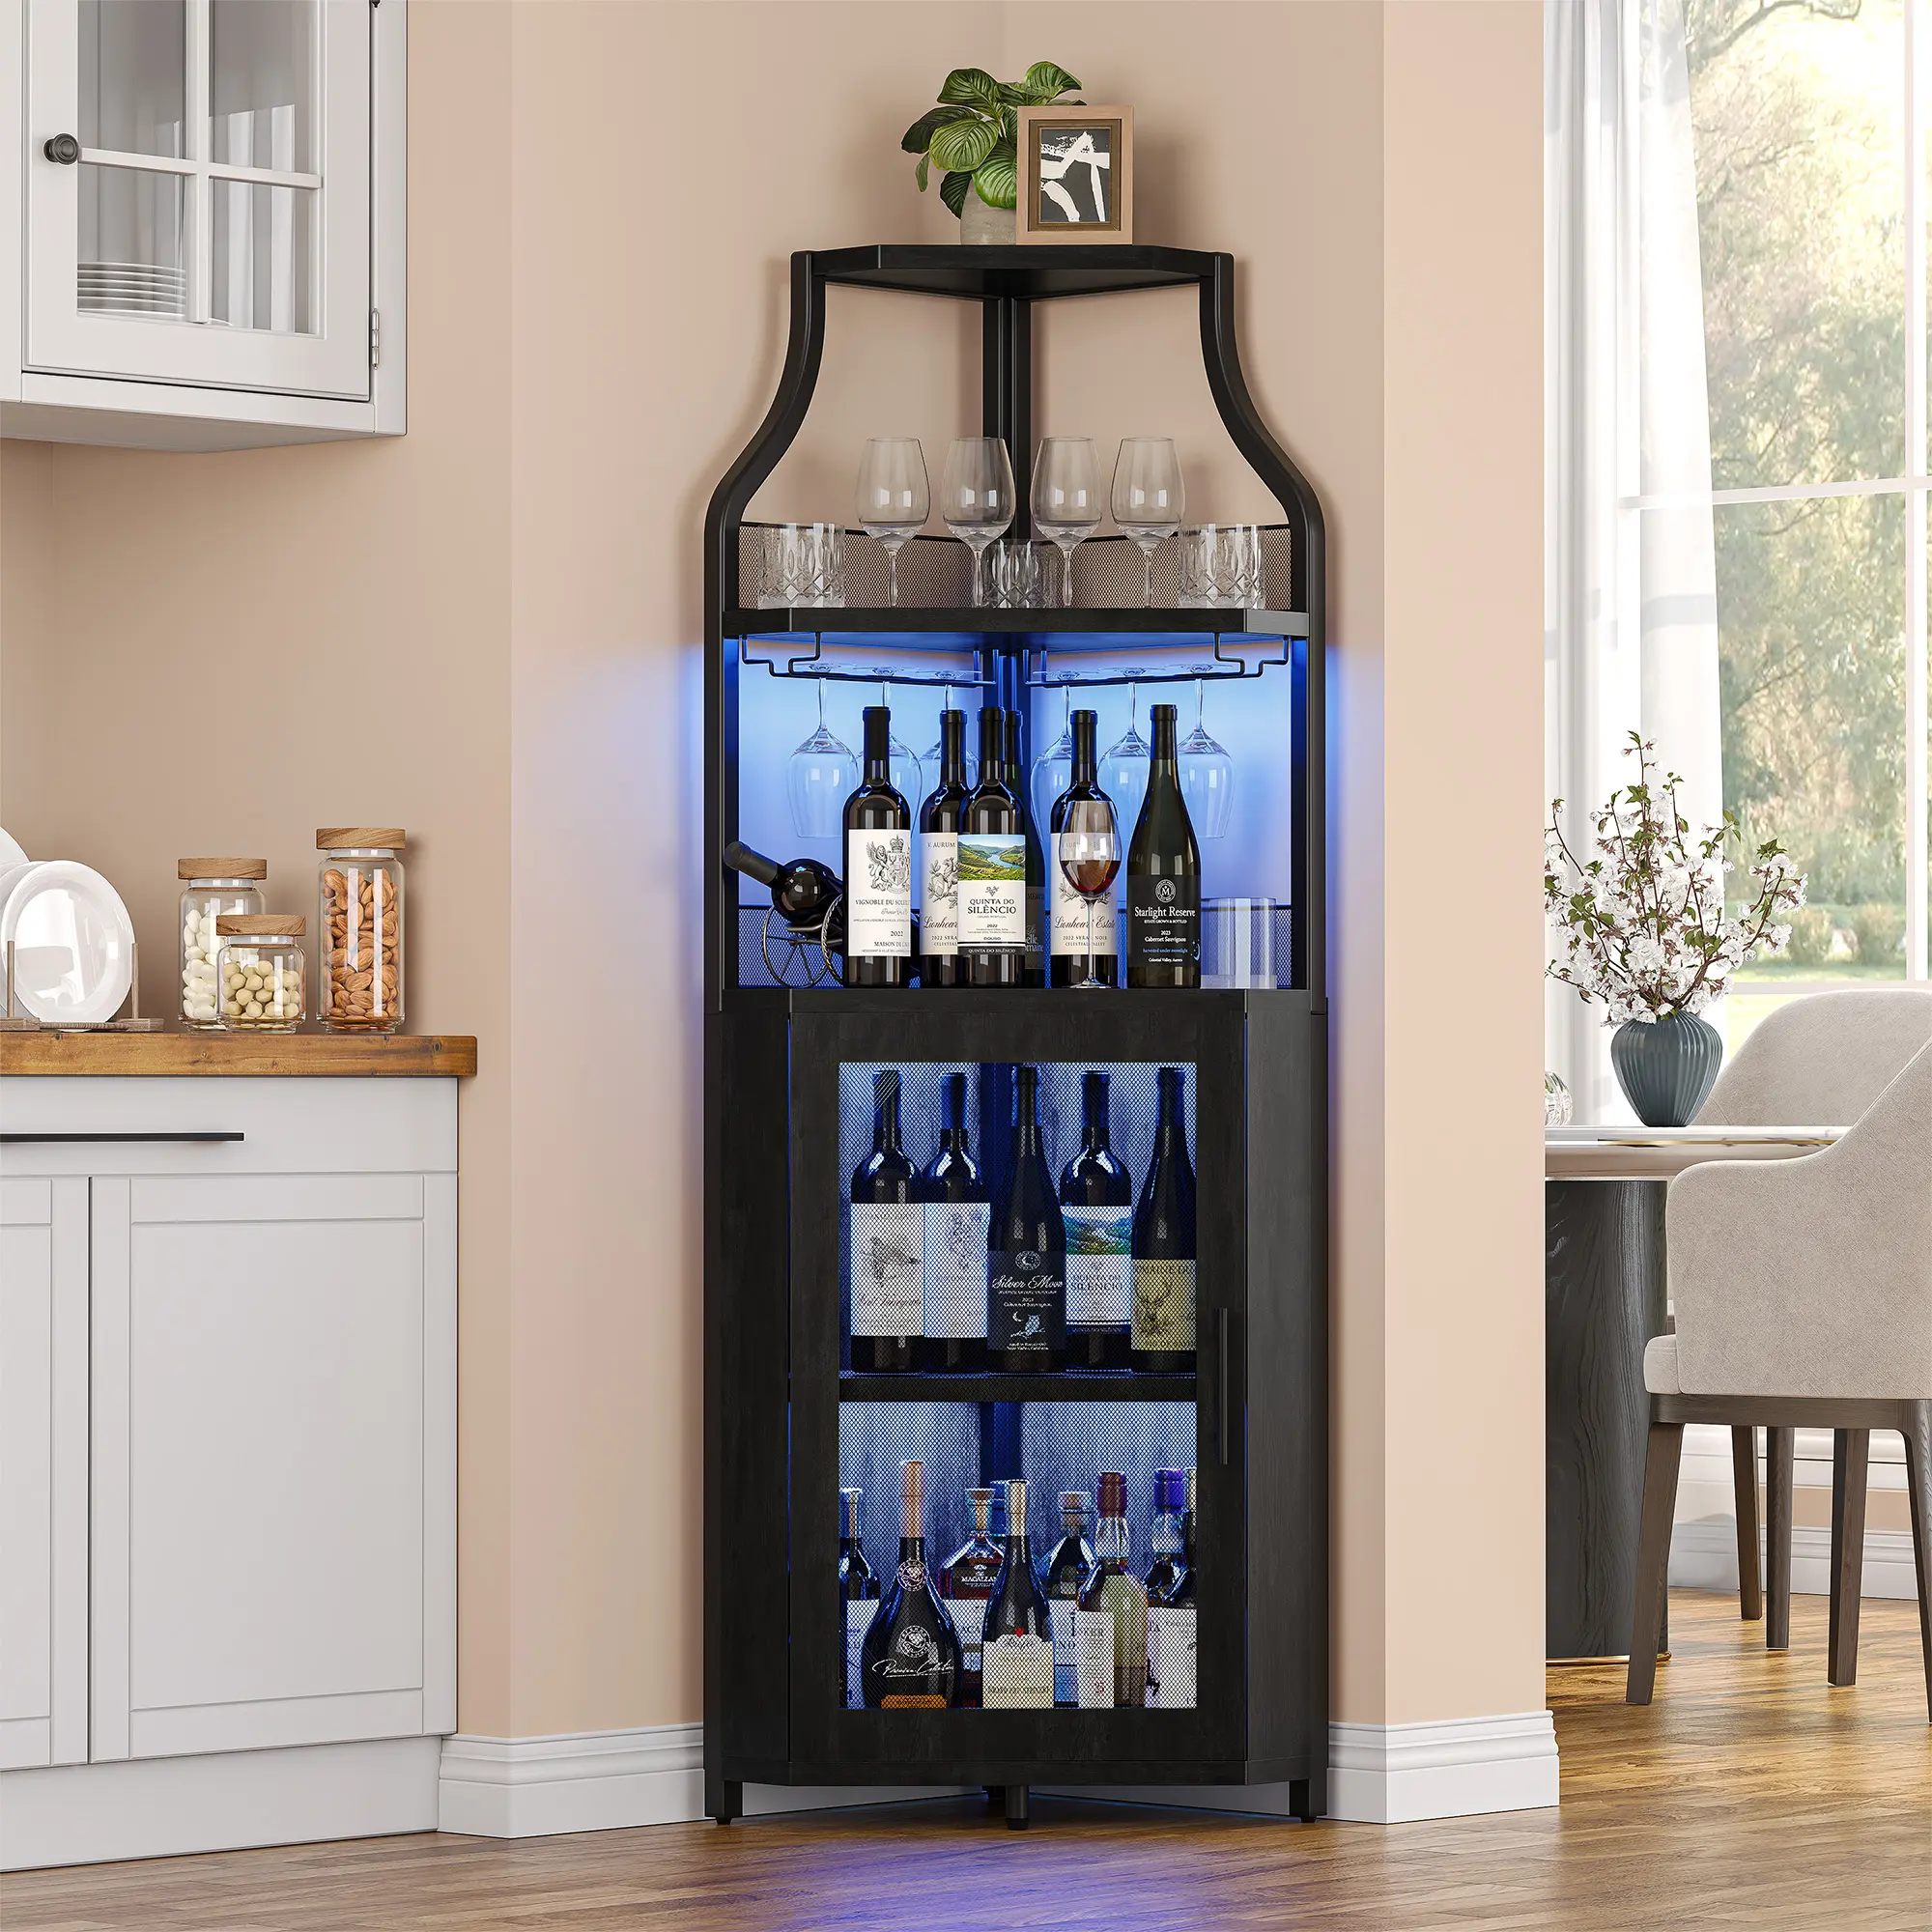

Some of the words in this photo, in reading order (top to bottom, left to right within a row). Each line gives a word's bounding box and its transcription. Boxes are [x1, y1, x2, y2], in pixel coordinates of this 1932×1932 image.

[967, 904, 1017, 914] SILÊNCIO
[1134, 906, 1167, 920] Starlight
[1168, 906, 1197, 917] Reserve
[923, 915, 958, 928] Lionhear
[992, 1274, 1026, 1289] Silver
[1027, 1274, 1064, 1290] Moon
